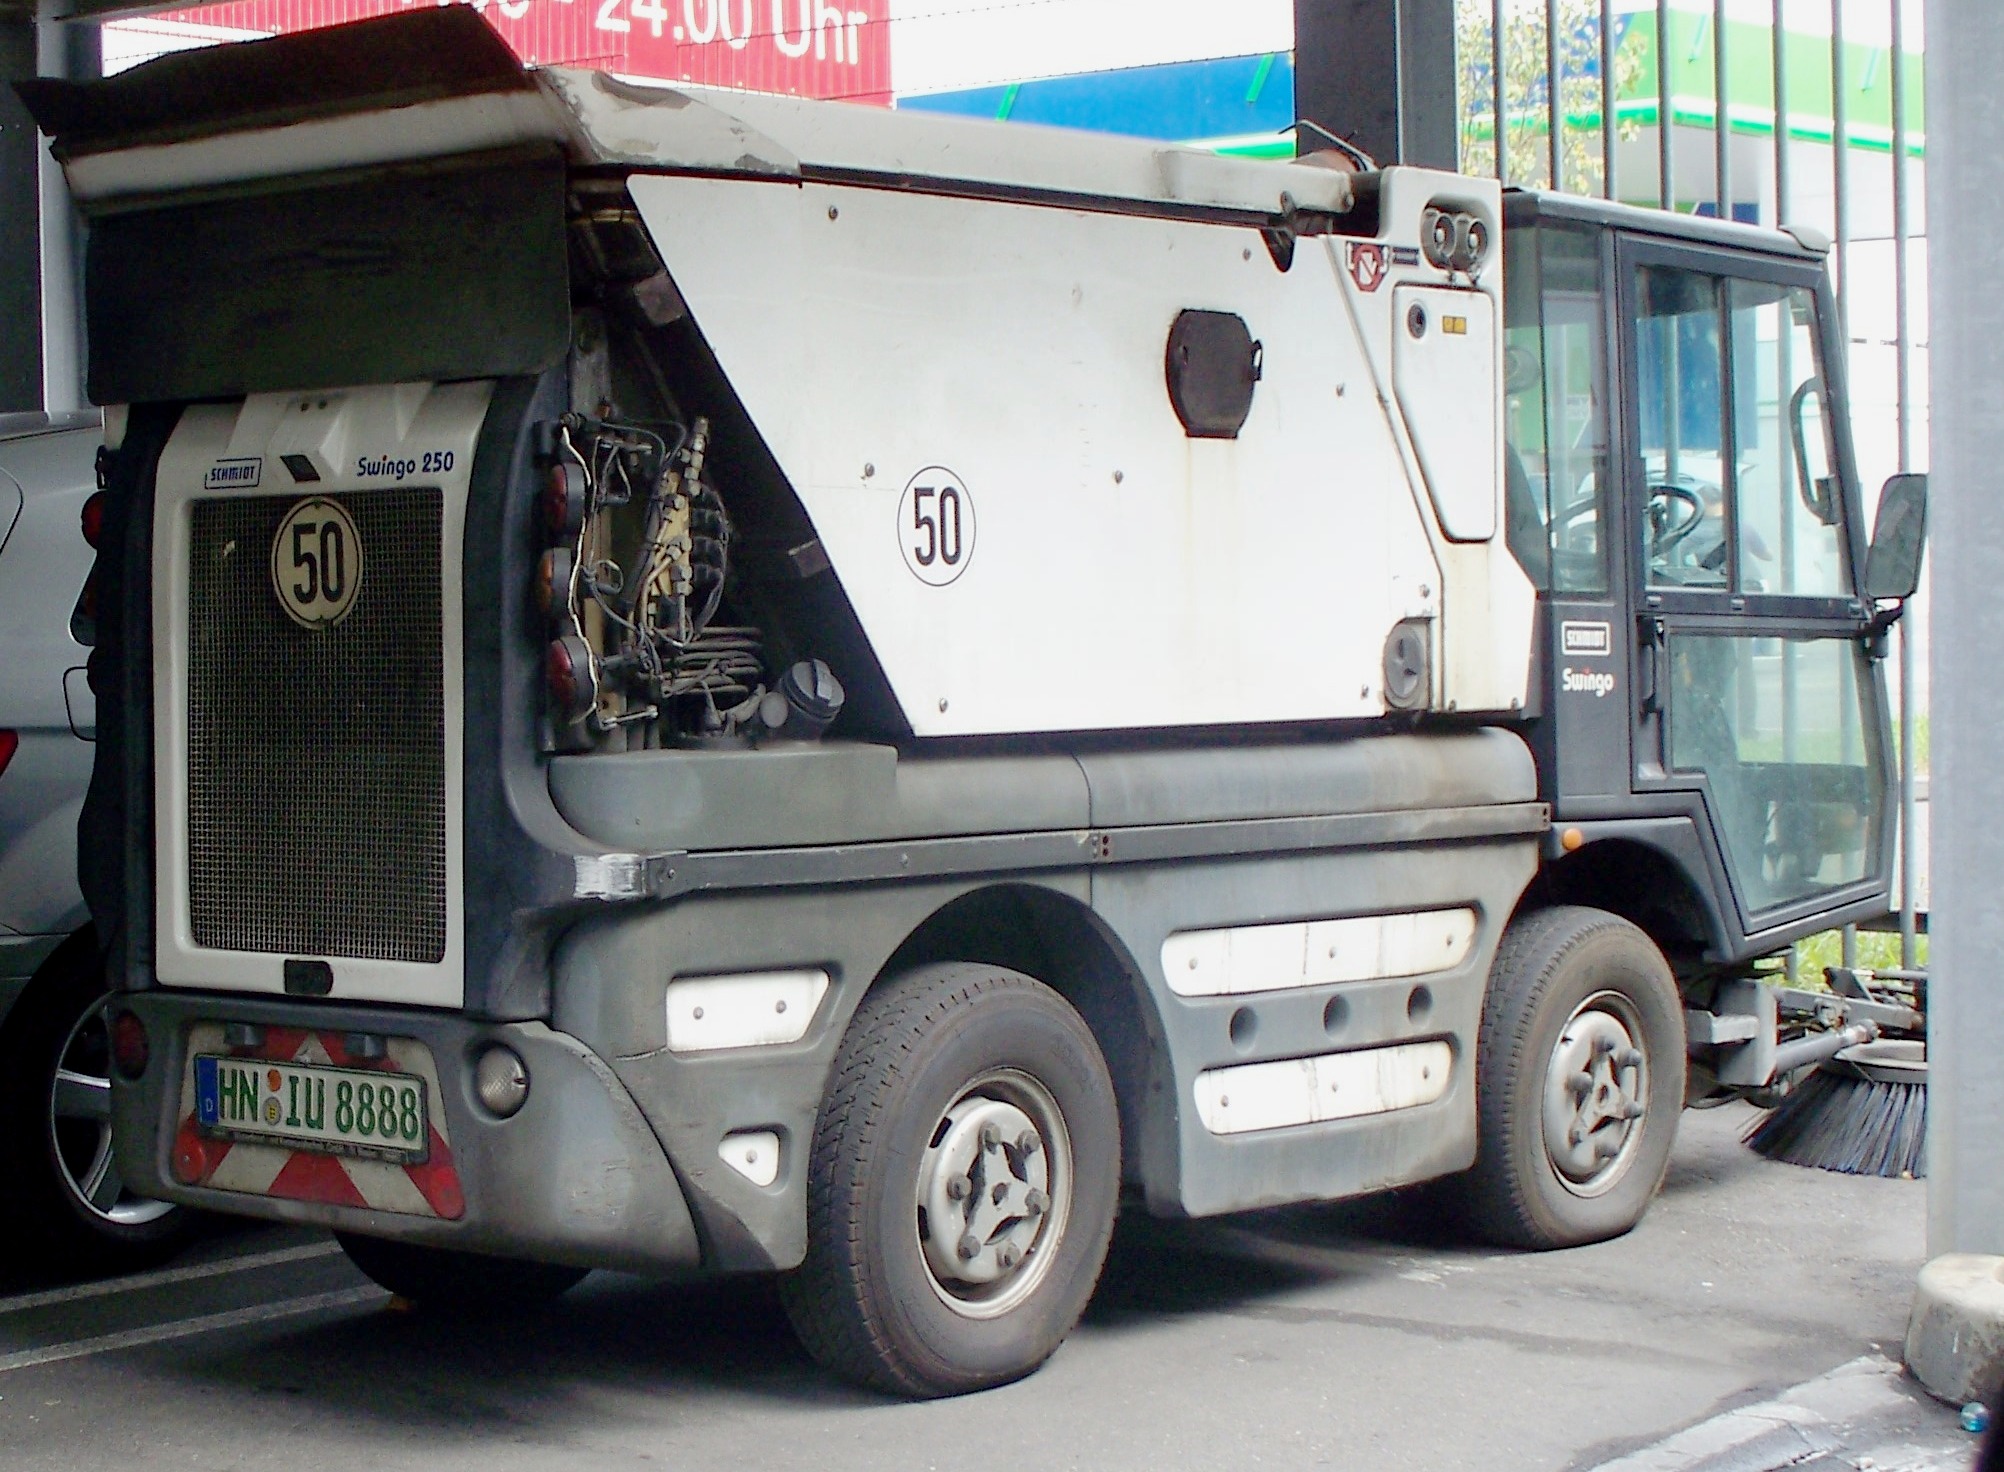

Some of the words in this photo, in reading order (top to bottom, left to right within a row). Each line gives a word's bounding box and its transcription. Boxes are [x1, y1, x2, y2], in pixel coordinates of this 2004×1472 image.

[772, 0, 868, 65] Uhr
[210, 466, 255, 481] SCHMIDT
[357, 454, 416, 480] Swingo
[421, 451, 454, 473] 250
[913, 486, 962, 566] 50
[292, 520, 345, 604] 50
[1562, 666, 1614, 698] Swingo
[205, 1097, 214, 1113] D
[219, 1067, 259, 1123] HN
[285, 1074, 326, 1130] IU
[335, 1080, 420, 1142] 8888
